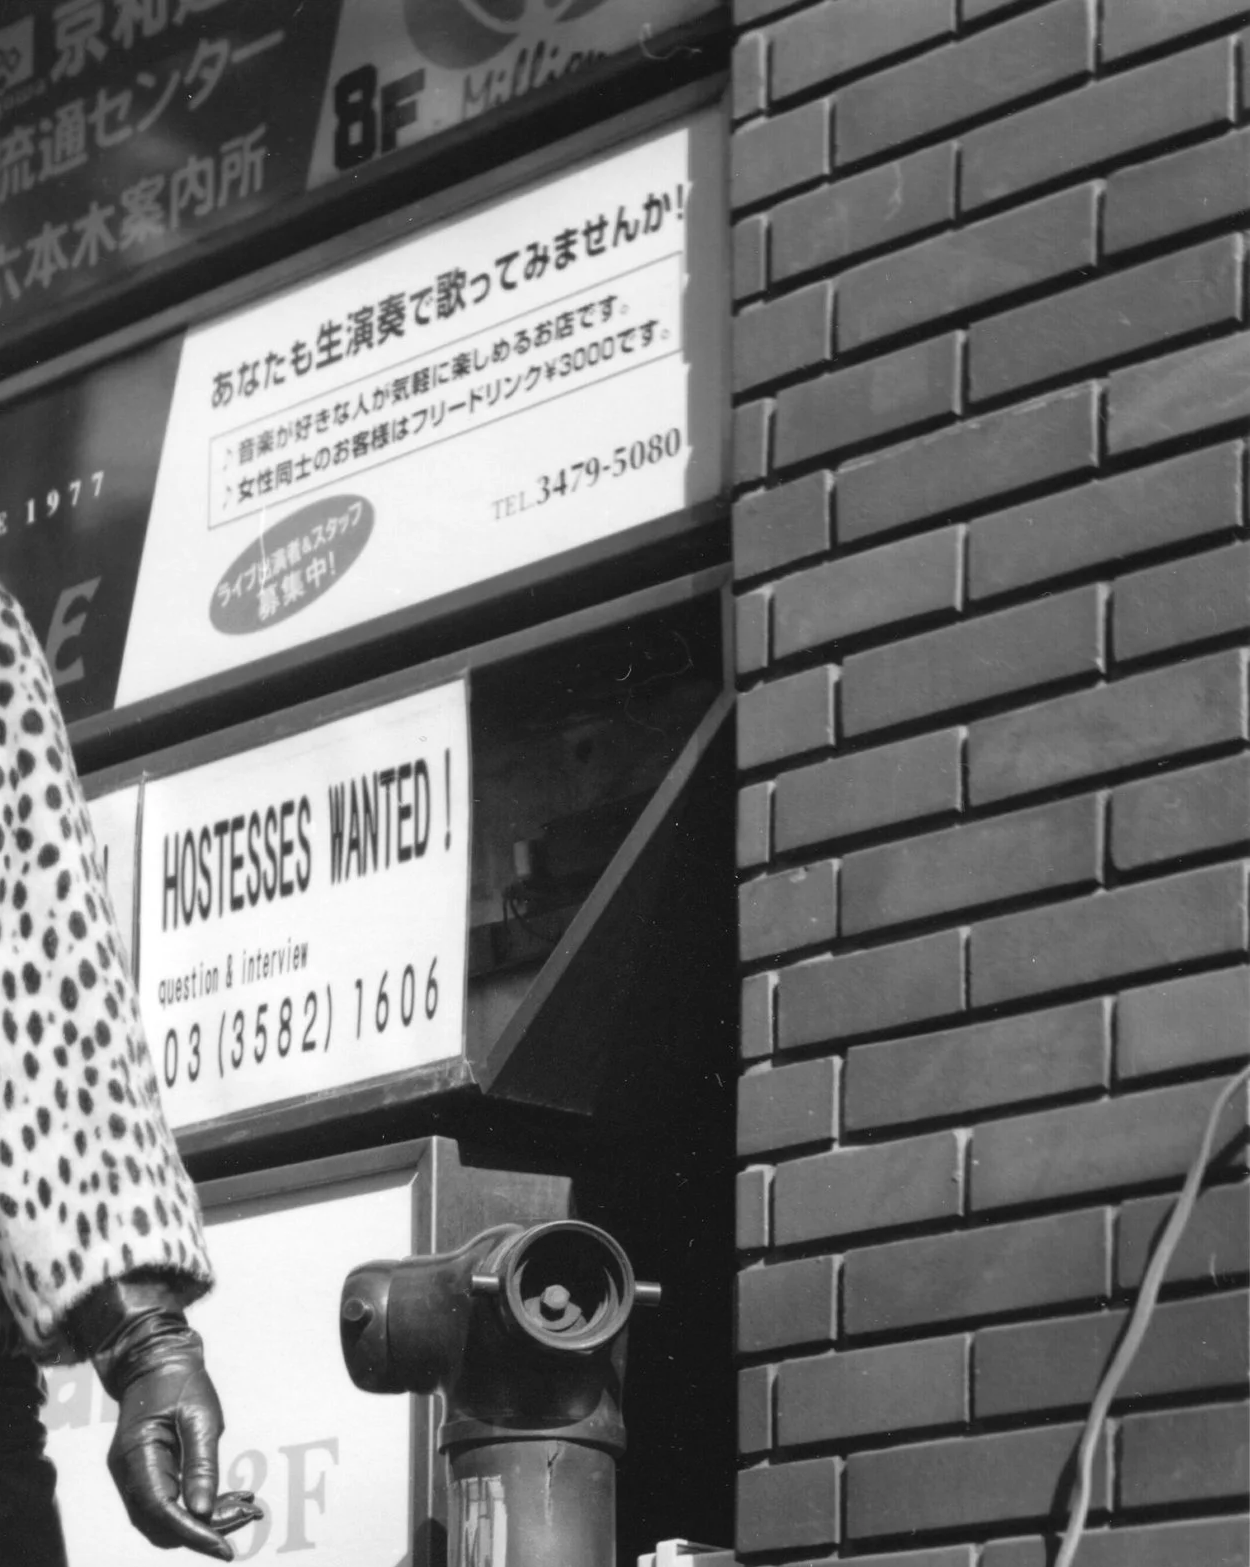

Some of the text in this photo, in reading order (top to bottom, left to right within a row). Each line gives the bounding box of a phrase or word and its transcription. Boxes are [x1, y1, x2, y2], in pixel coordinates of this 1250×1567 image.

[333, 62, 426, 170] 8F
[24, 470, 105, 525] 1977
[161, 795, 312, 933] HOSTESSES
[158, 939, 310, 1006] question & interview
[225, 1436, 340, 1563] 3F
